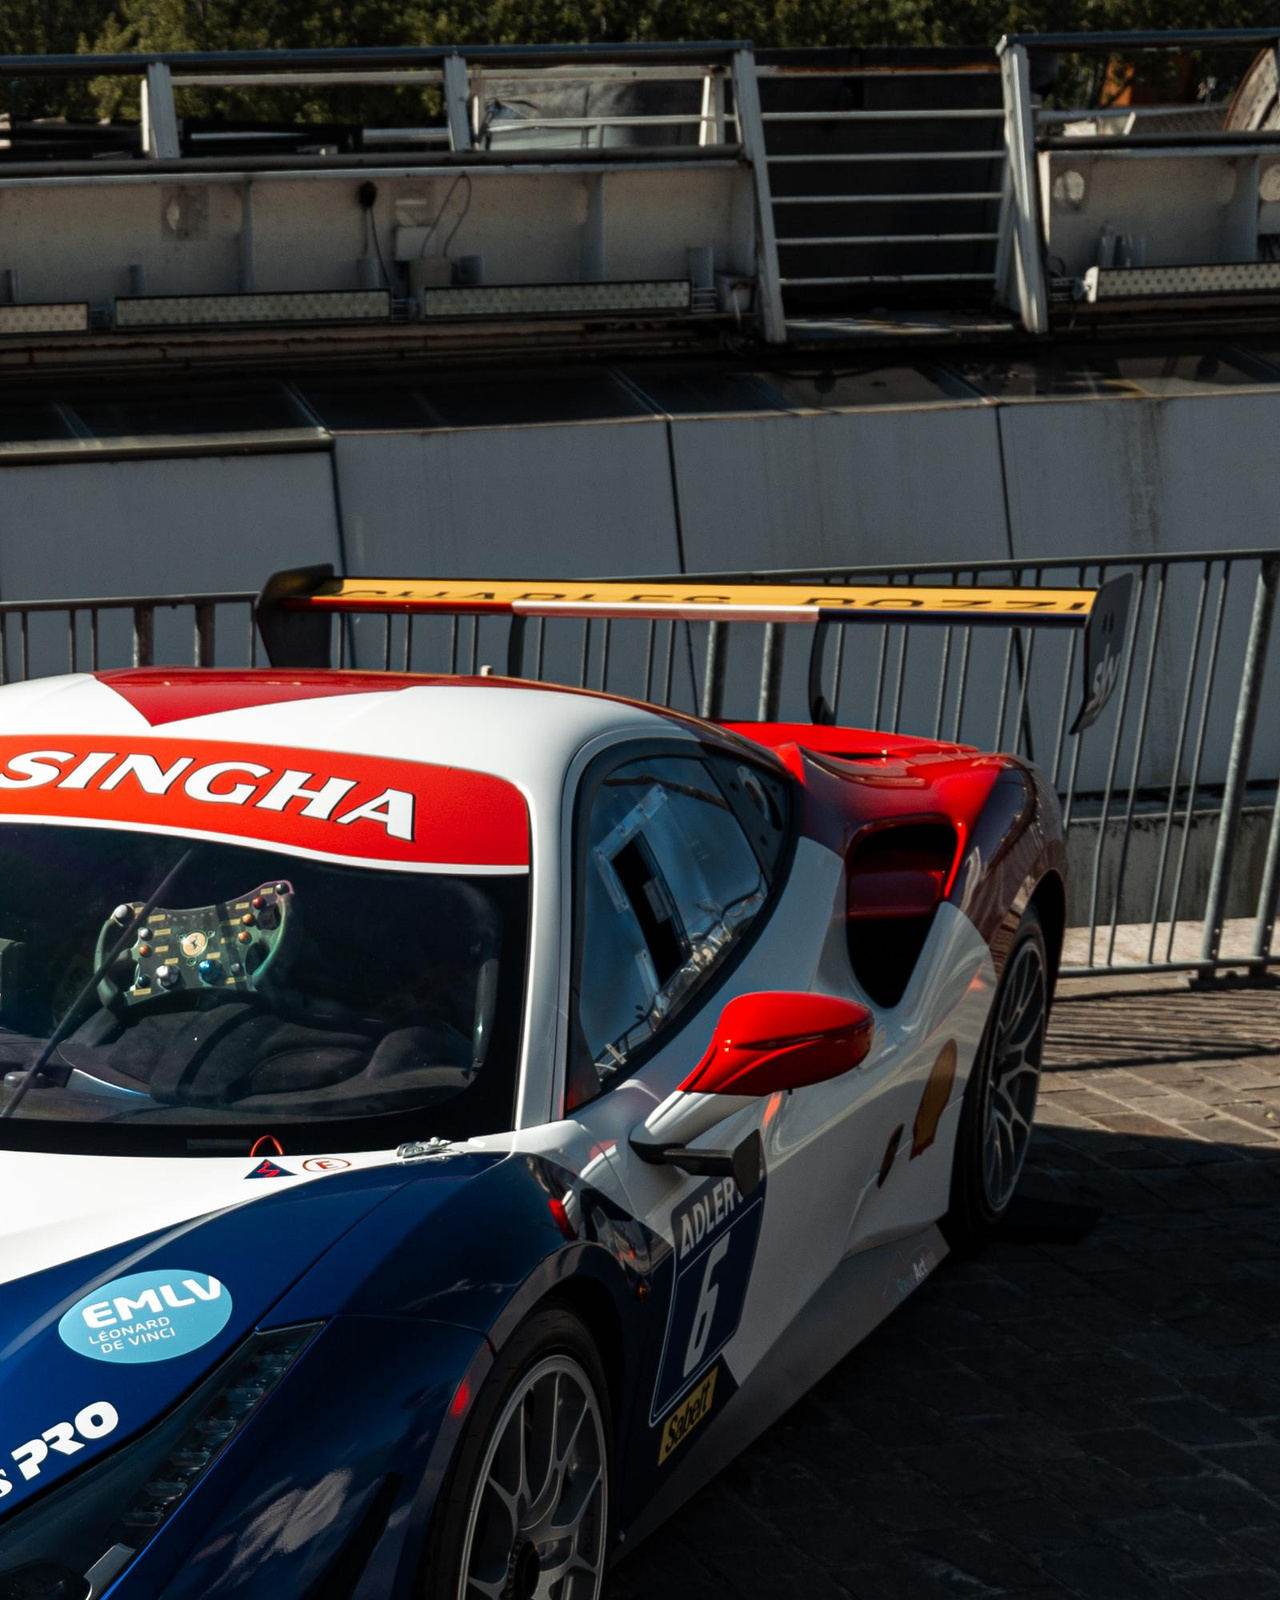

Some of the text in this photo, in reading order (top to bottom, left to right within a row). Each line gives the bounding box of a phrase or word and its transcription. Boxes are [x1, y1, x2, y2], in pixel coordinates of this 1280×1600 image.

[81, 1275, 222, 1329] EMLV
[88, 1315, 171, 1346] LÉONARD
[683, 1231, 731, 1378] 6
[100, 1326, 176, 1354] DE VINCI
[11, 1400, 120, 1481] PRO
[663, 1380, 711, 1454] Sabelt
